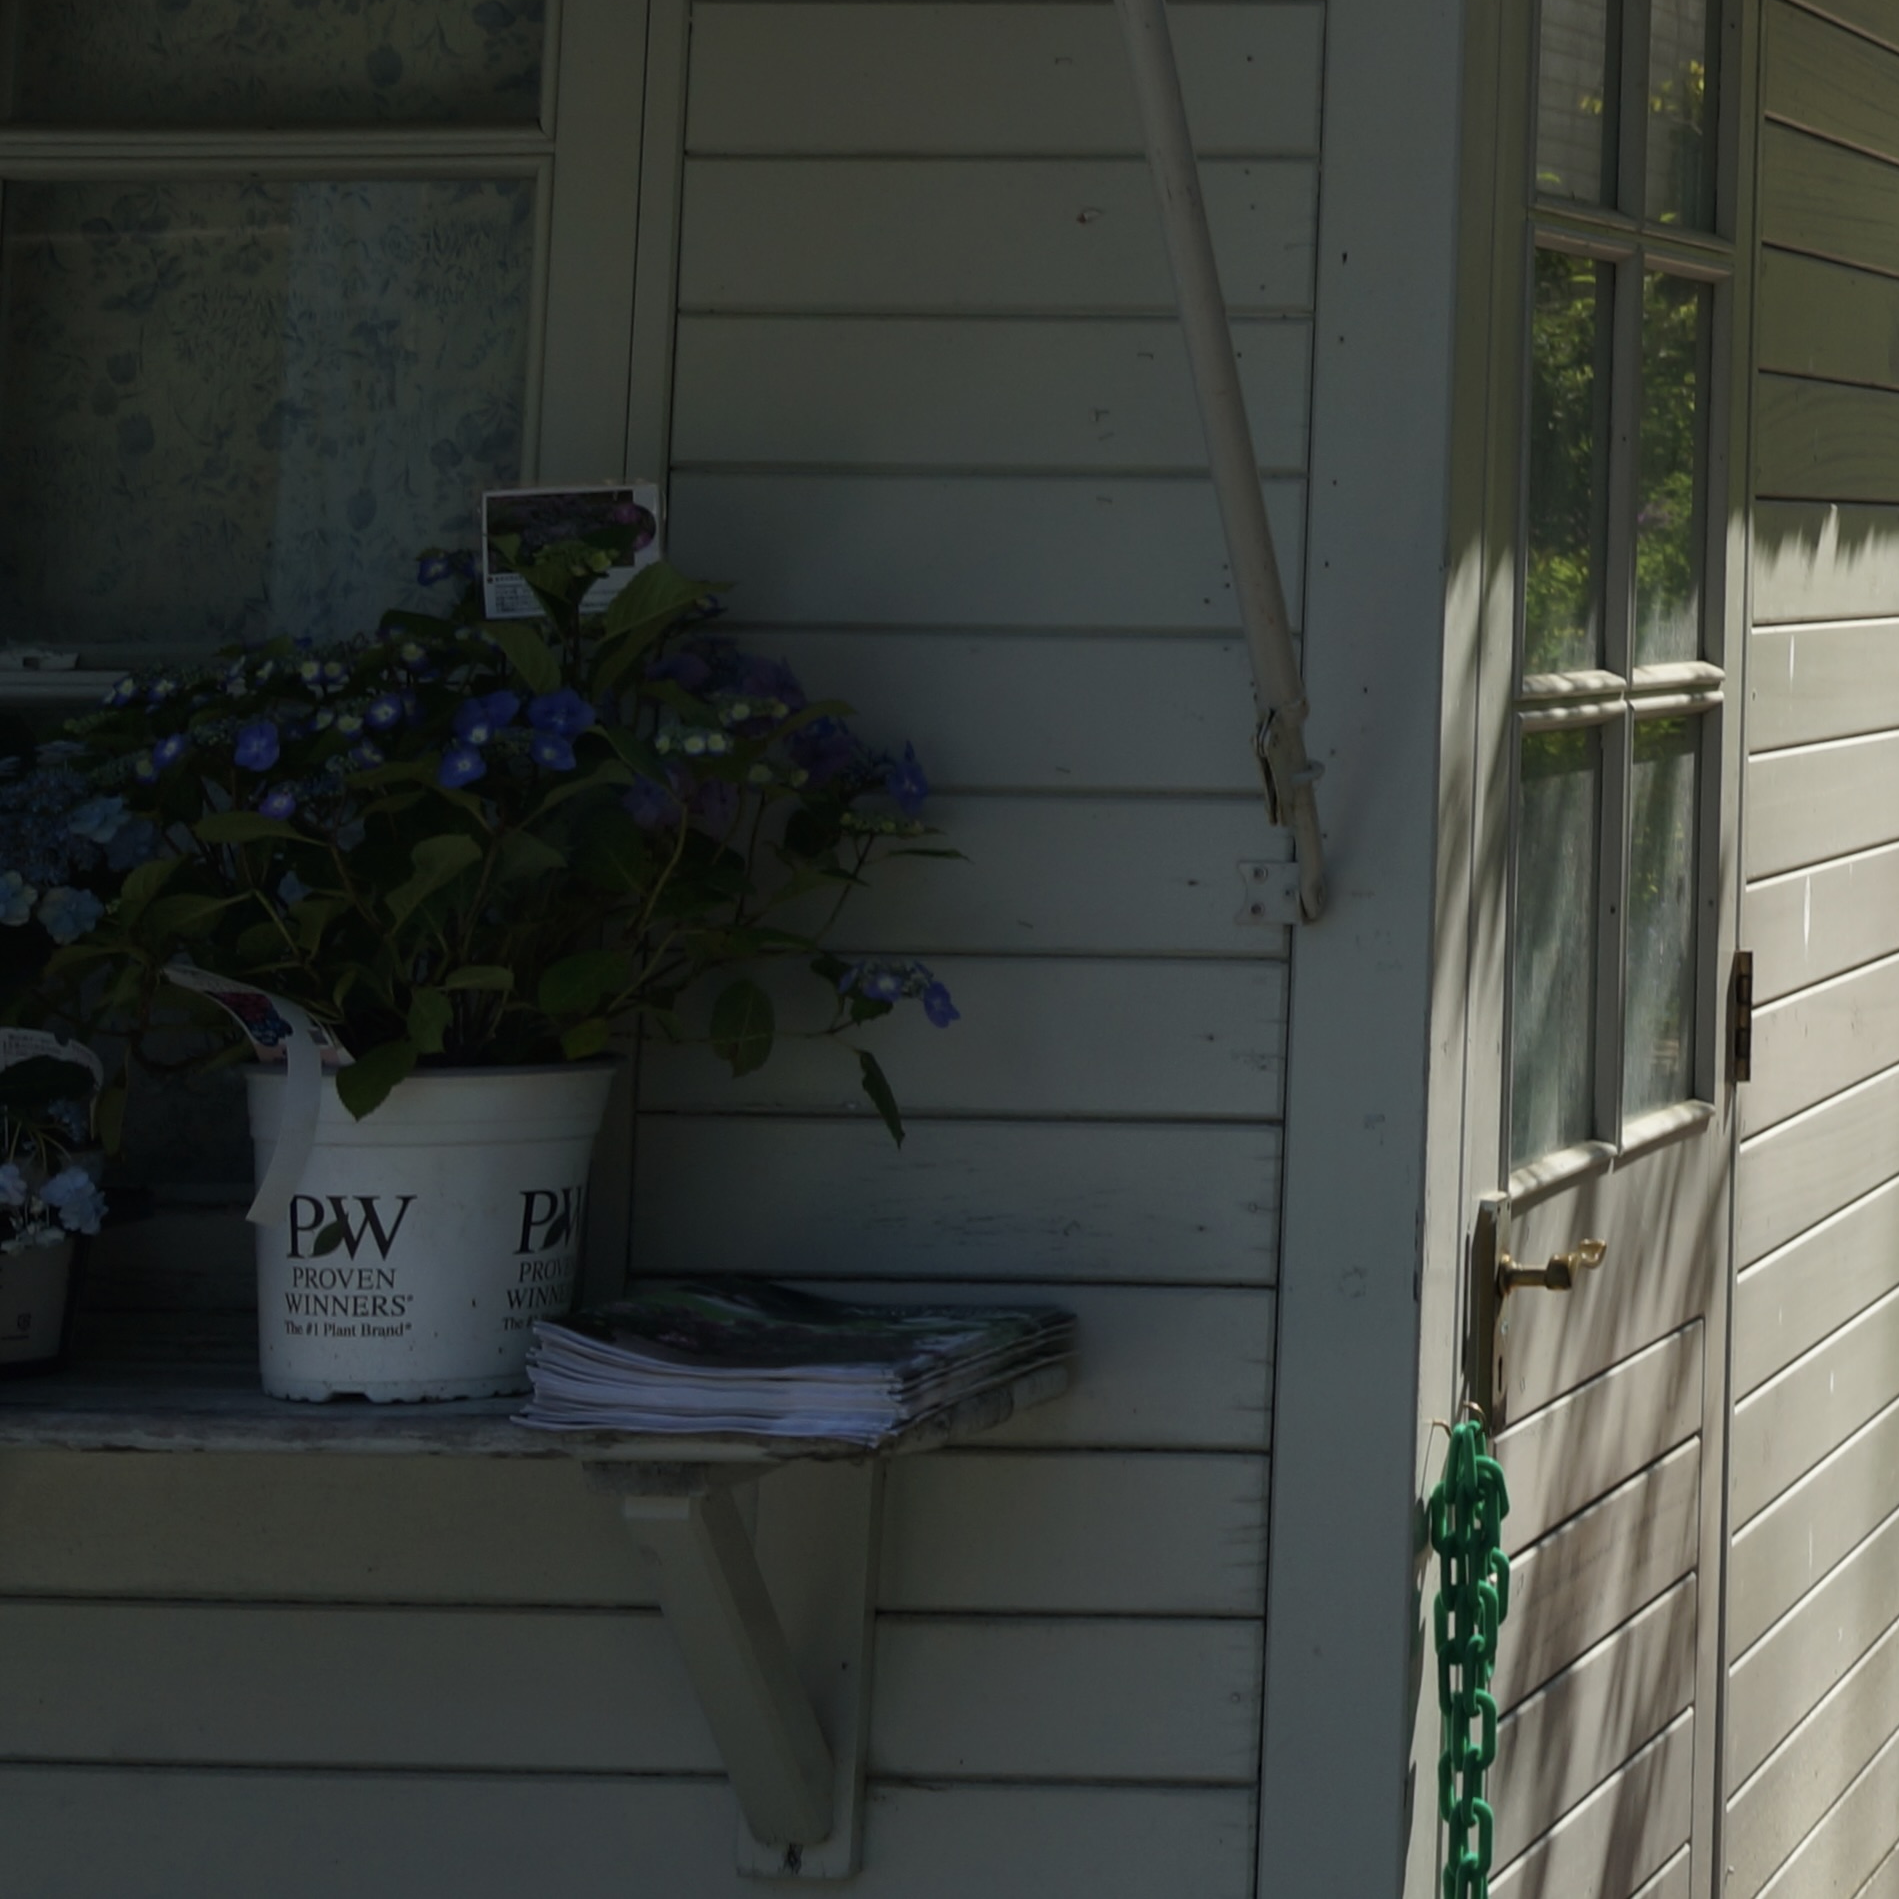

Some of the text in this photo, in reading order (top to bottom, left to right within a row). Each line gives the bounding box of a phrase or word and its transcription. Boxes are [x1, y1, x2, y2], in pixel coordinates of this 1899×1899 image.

[286, 1194, 418, 1261] PW
[293, 1266, 396, 1290] PROVEN
[284, 1319, 304, 1336] The
[323, 1322, 356, 1338] Plant
